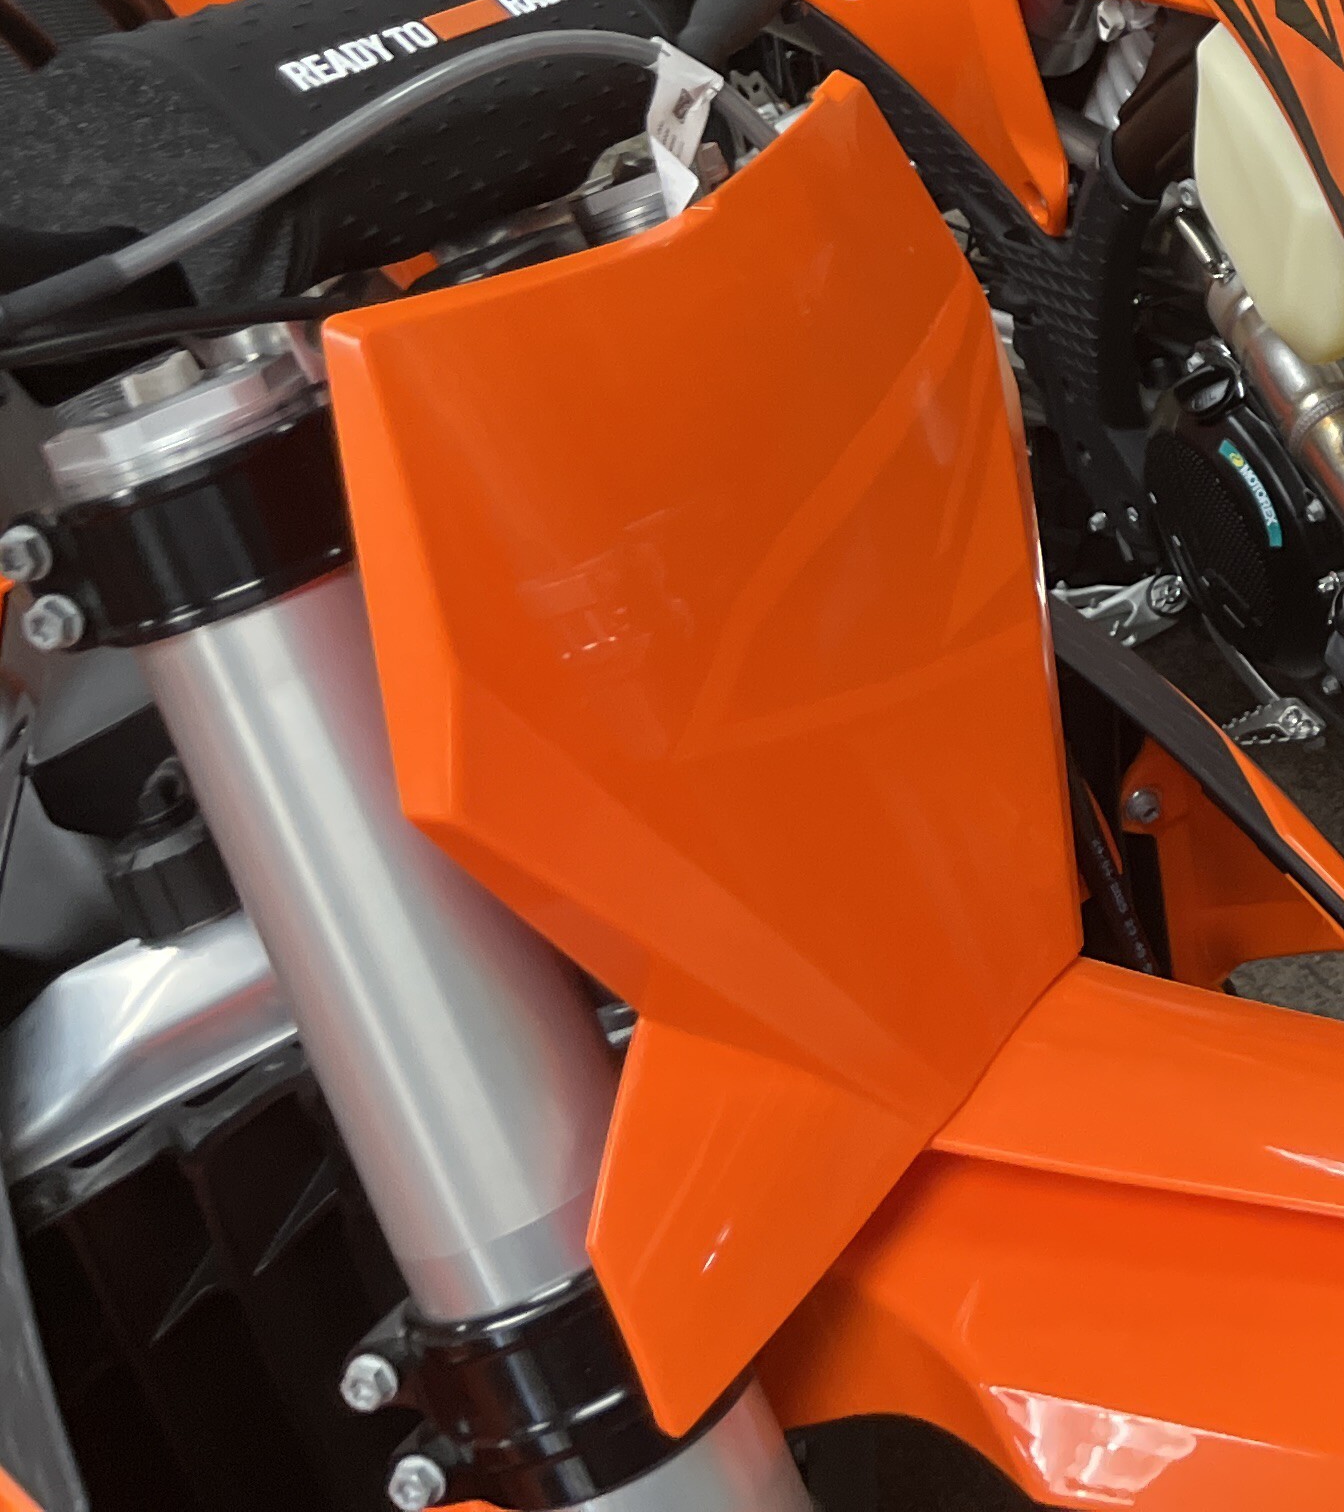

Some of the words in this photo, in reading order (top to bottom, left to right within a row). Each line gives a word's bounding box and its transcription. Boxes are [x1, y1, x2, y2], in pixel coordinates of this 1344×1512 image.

[278, 34, 395, 92] READY
[382, 20, 439, 54] TO
[1239, 463, 1279, 527] MOTOREX
